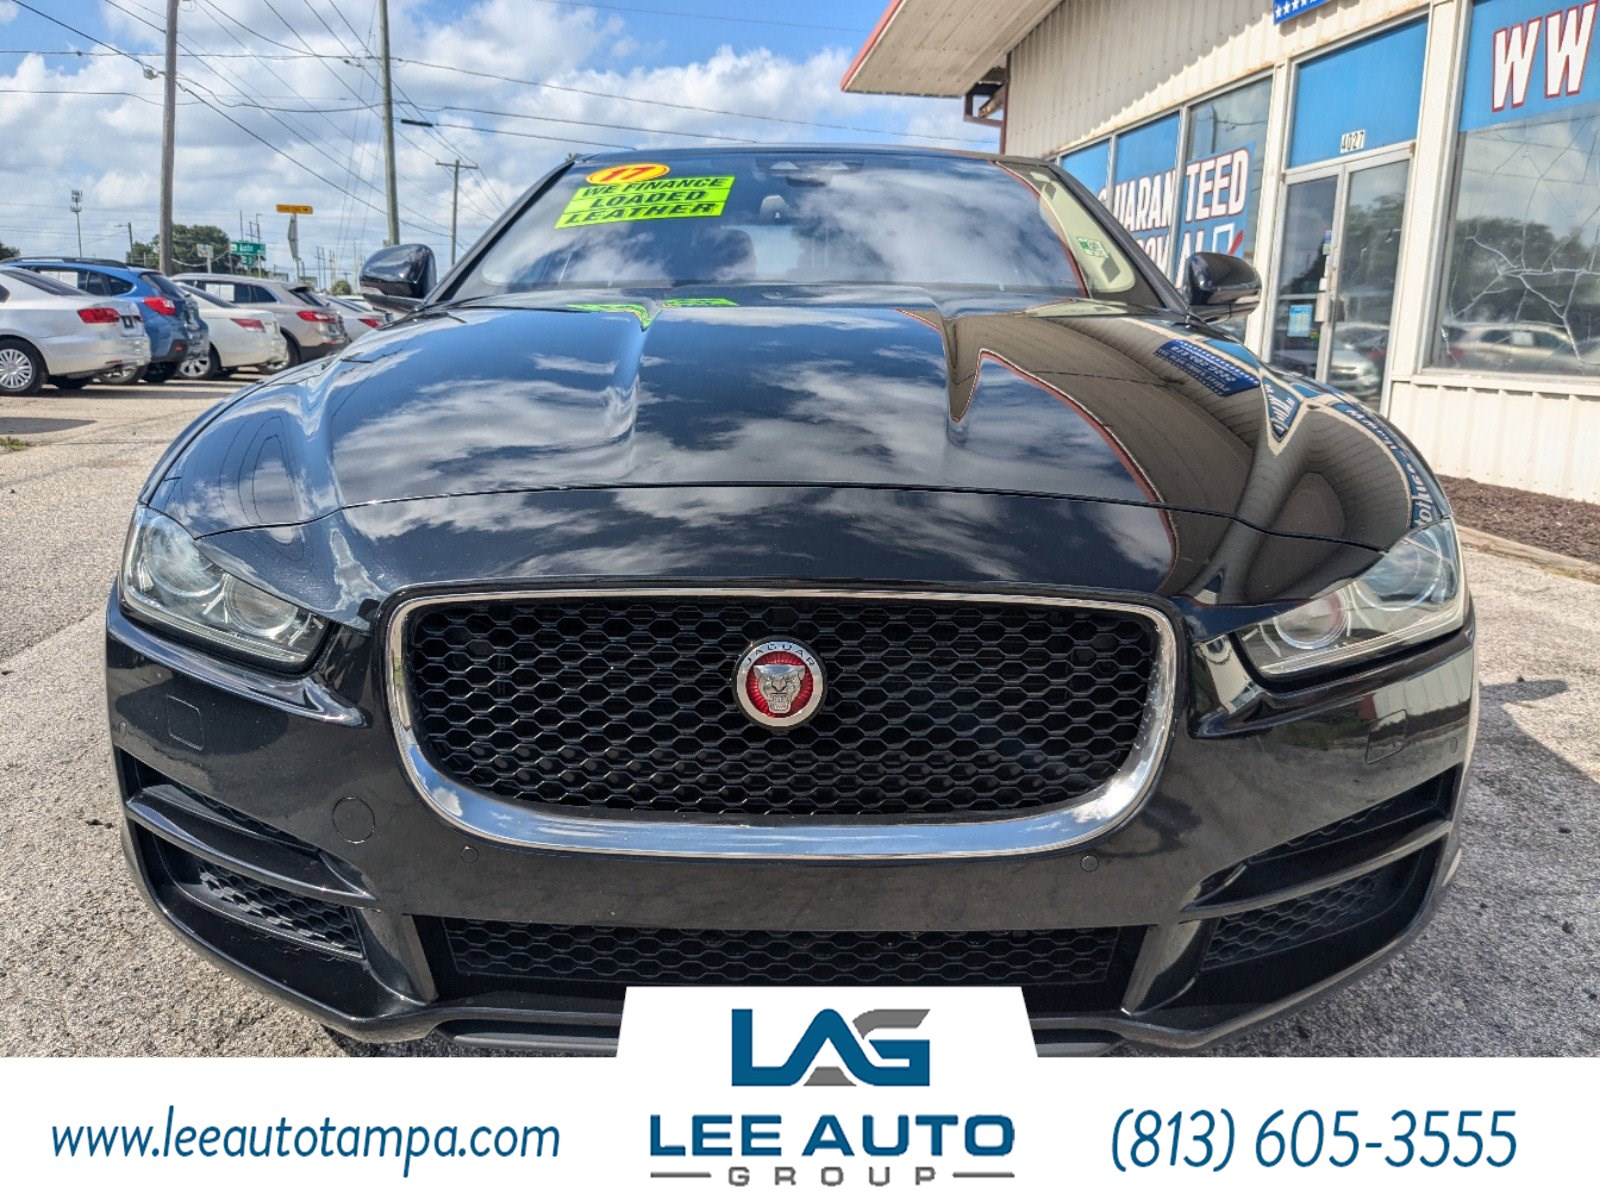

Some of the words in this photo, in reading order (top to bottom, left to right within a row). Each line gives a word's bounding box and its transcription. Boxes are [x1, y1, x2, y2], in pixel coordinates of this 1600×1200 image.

[1341, 131, 1364, 150] 4027
[581, 185, 619, 197] WE
[623, 178, 726, 195] FINANCE
[1098, 148, 1250, 232] UARANTEED
[590, 191, 707, 208] LOADED
[565, 203, 717, 224] LEATHER
[746, 643, 815, 666] JAGUAR
